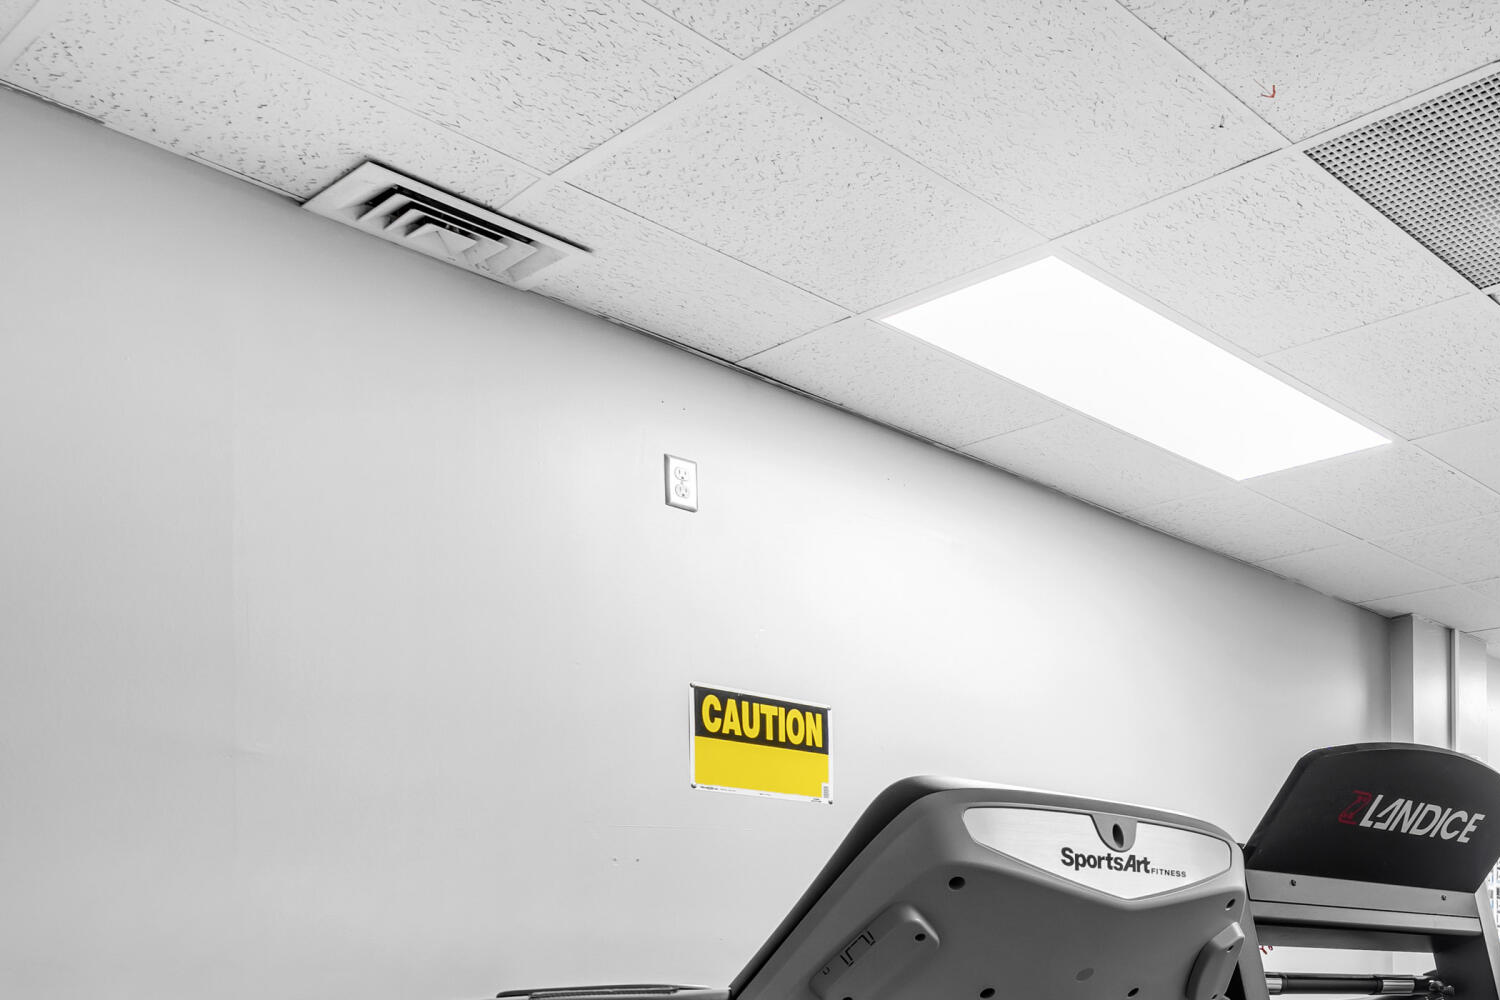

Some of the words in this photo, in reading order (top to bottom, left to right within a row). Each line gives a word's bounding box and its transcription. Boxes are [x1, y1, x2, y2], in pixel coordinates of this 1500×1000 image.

[701, 694, 823, 748] CAUTION
[1359, 794, 1486, 843] LANDICE
[1061, 847, 1150, 873] SportsArt
[1151, 868, 1187, 878] FITNESS
